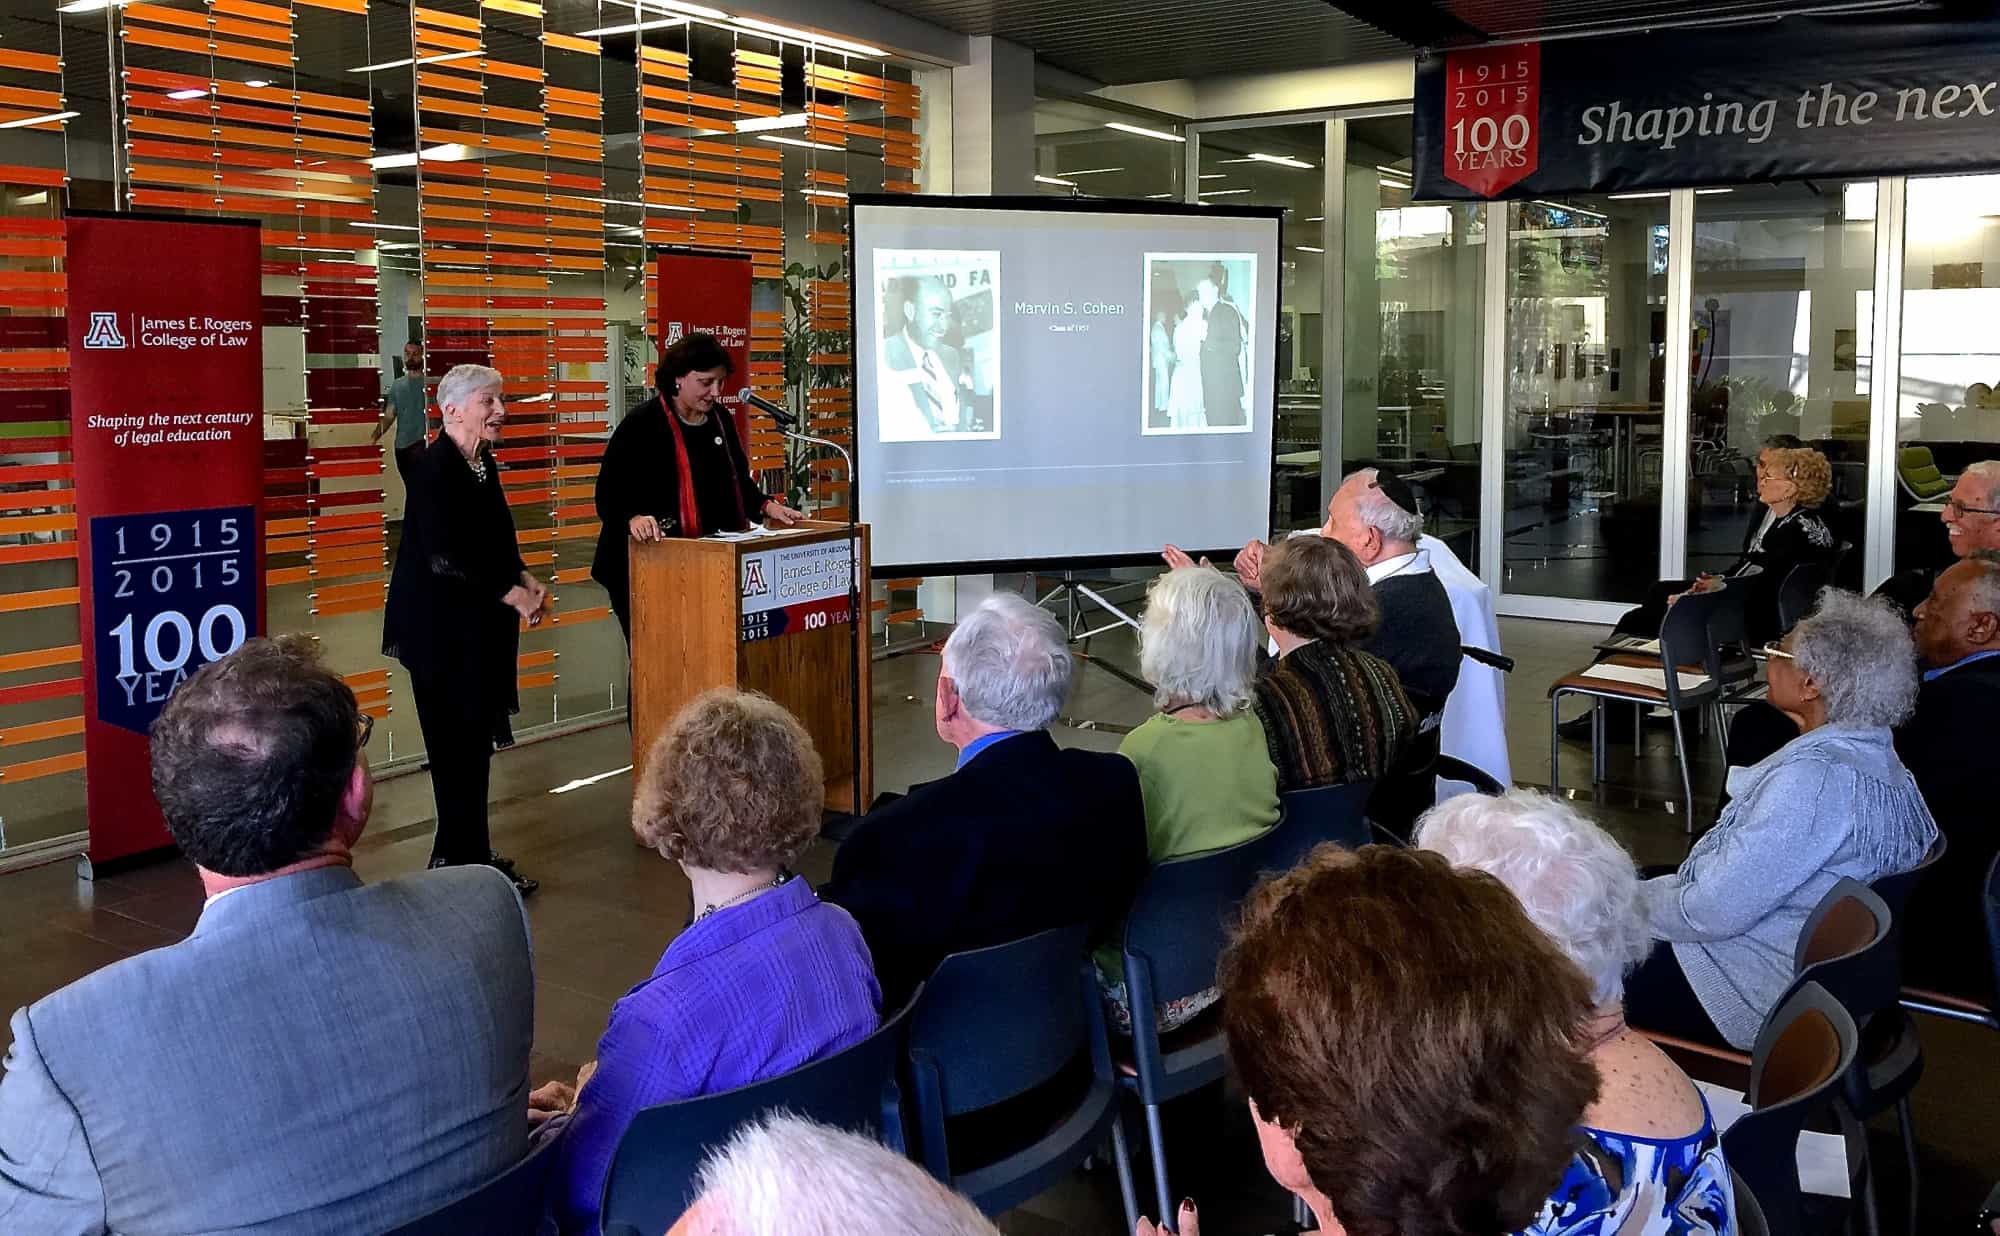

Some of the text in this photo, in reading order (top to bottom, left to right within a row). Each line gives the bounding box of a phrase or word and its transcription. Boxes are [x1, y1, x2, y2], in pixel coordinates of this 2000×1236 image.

[1456, 61, 1529, 84] 1915
[1455, 86, 1528, 108] 2015
[1578, 82, 1997, 149] Shaping the nex
[1451, 114, 1530, 154] 100
[1454, 148, 1527, 170] YEARS
[1015, 301, 1124, 314] Marvin S. Cohen
[141, 316, 253, 333] James E. Rogers
[723, 325, 746, 337] Rogers
[141, 332, 248, 349] College of Law
[720, 337, 744, 347] of Law
[87, 412, 253, 430] Shaping the next century
[114, 427, 231, 446] of legal education
[115, 518, 239, 554] 1915
[114, 559, 240, 598] 2015
[780, 558, 860, 584] James E. Roges
[780, 580, 818, 597] College
[822, 575, 832, 590] of
[804, 607, 860, 630] 100 YEAS
[109, 604, 246, 677] 100
[115, 668, 188, 706] YEA
